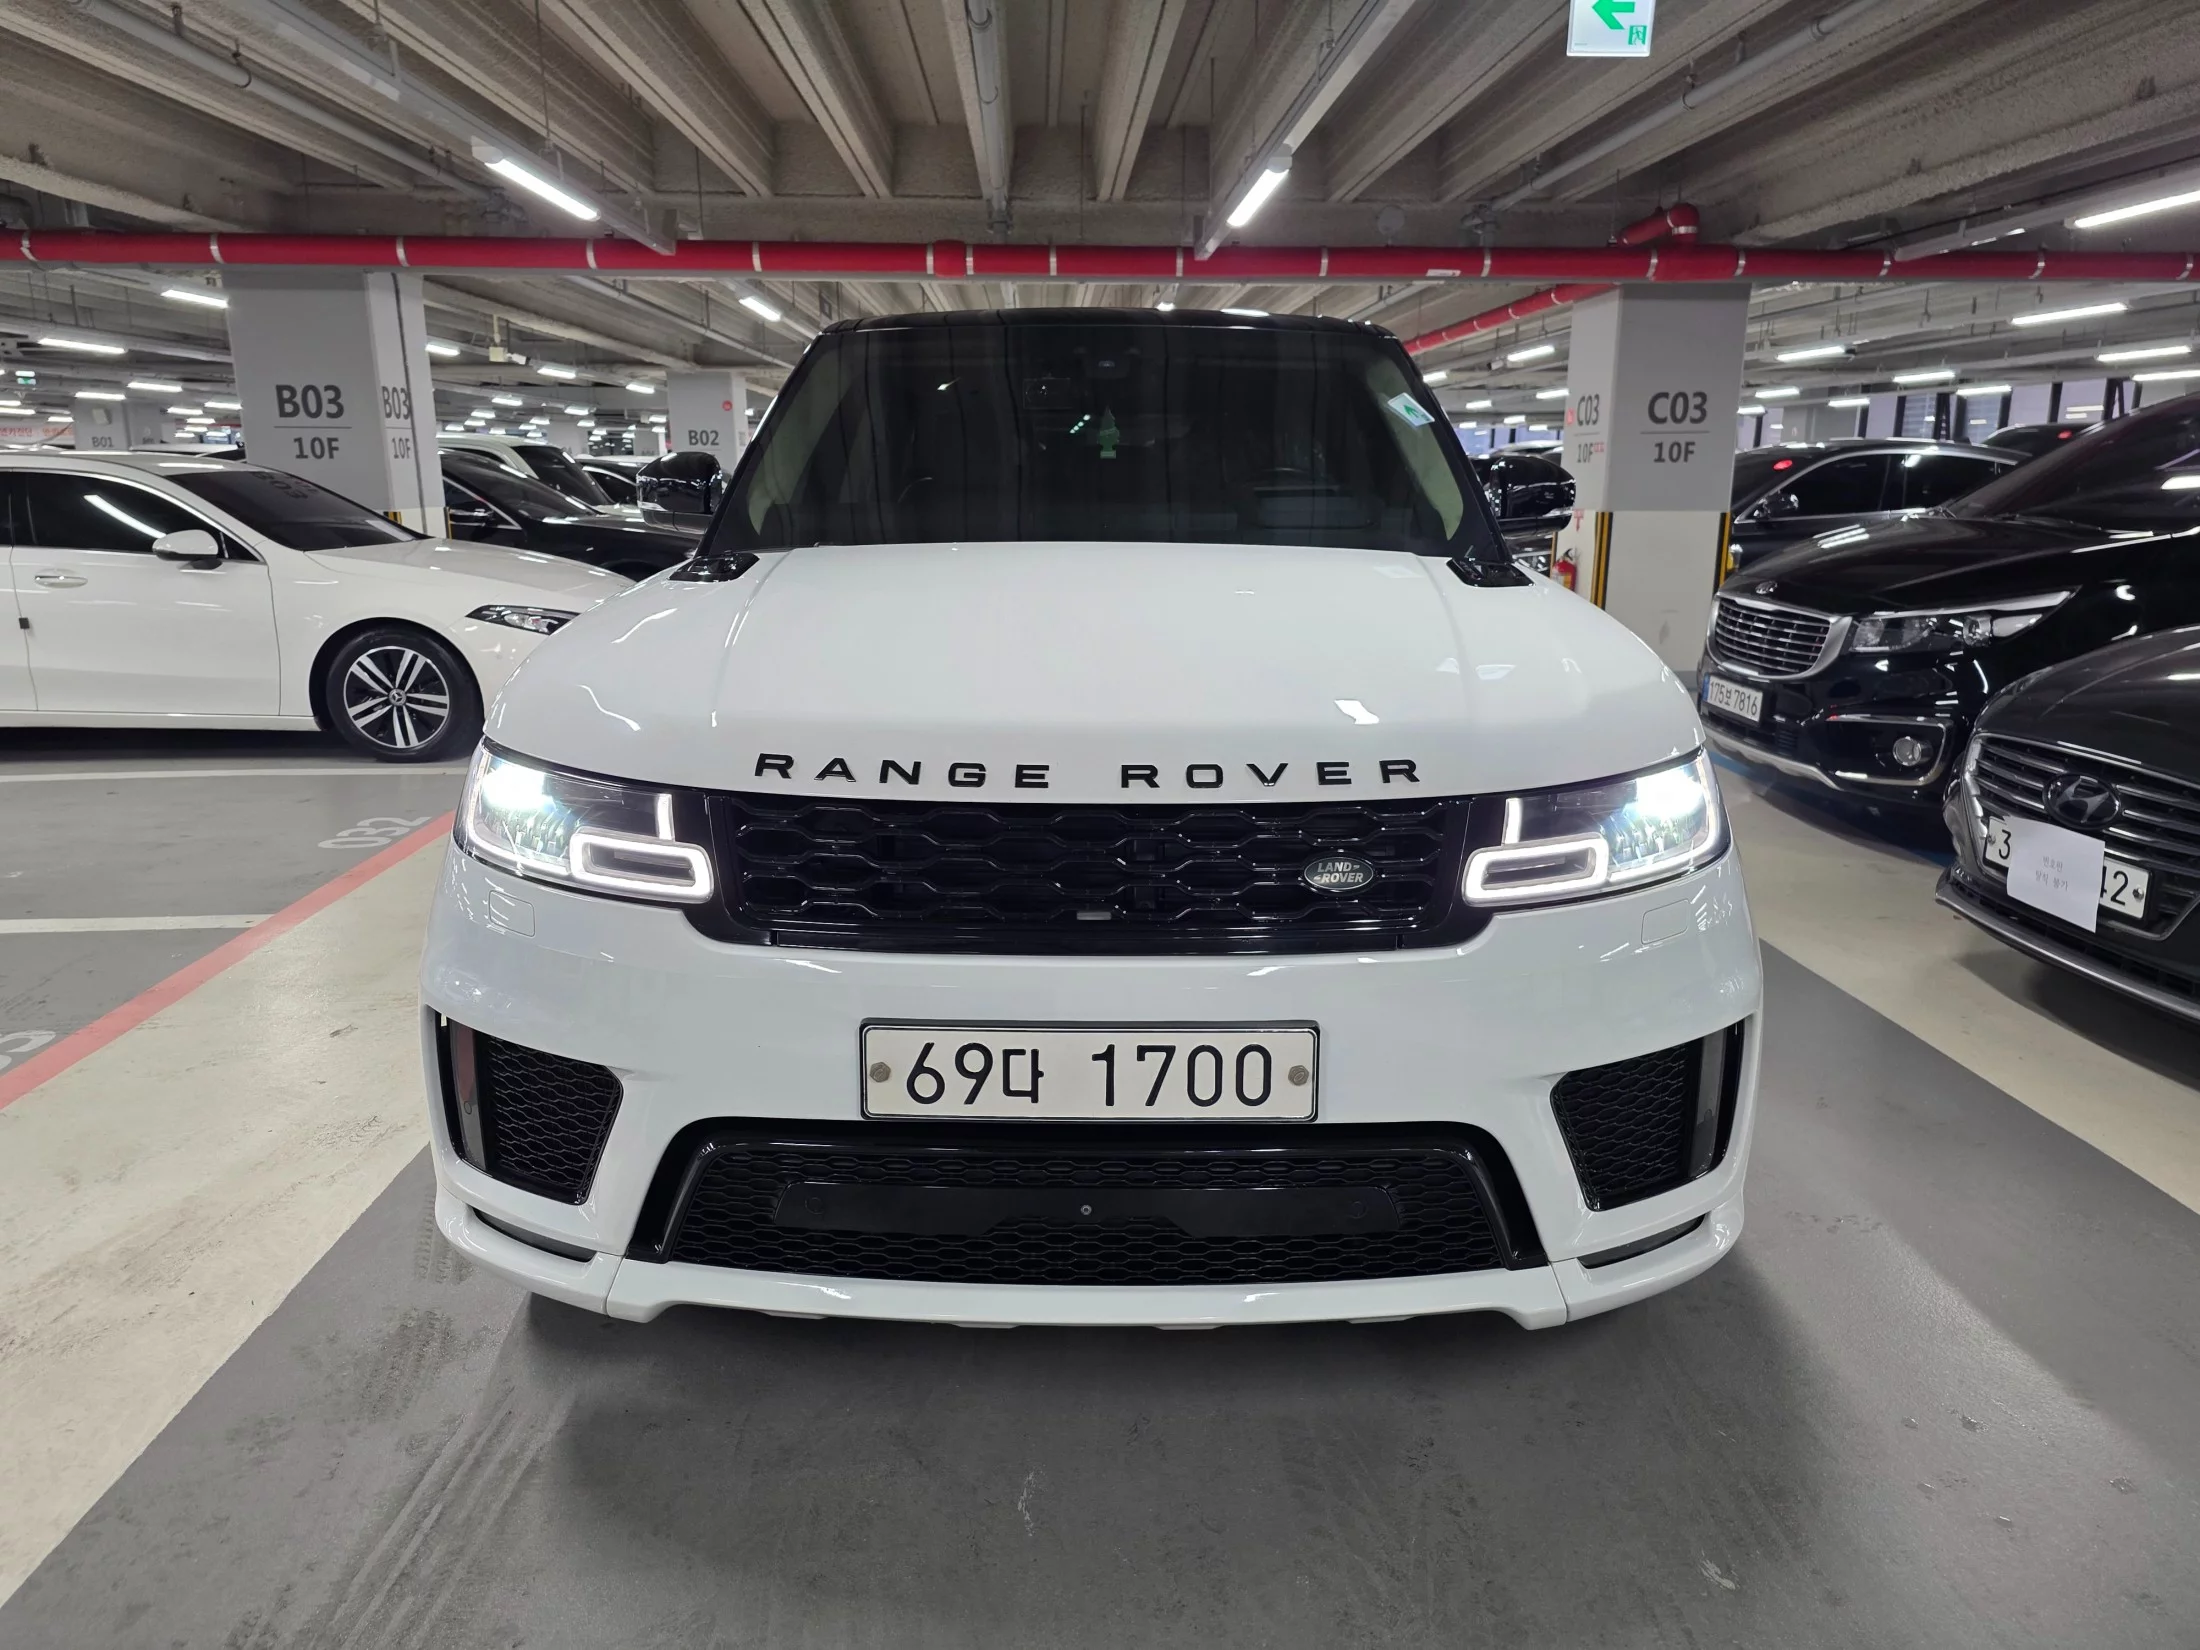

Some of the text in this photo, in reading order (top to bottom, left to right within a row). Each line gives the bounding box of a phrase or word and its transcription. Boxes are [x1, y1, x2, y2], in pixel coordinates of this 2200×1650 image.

[276, 384, 344, 419] B03
[382, 386, 411, 420] B03
[1577, 394, 1600, 426] C03
[1648, 391, 1708, 425] C03
[92, 436, 114, 448] B01
[293, 437, 340, 459] 10F
[392, 437, 411, 459] 10F
[688, 430, 719, 446] B02
[1577, 442, 1594, 463] 10F
[1653, 441, 1696, 463] 10F
[1733, 689, 1758, 716] 7816
[753, 752, 1421, 790] RANGE ROVER
[317, 816, 433, 849] 032
[1317, 862, 1352, 873] LAND
[1321, 872, 1364, 883] ROVER
[905, 1042, 1273, 1107] 69다 1700
